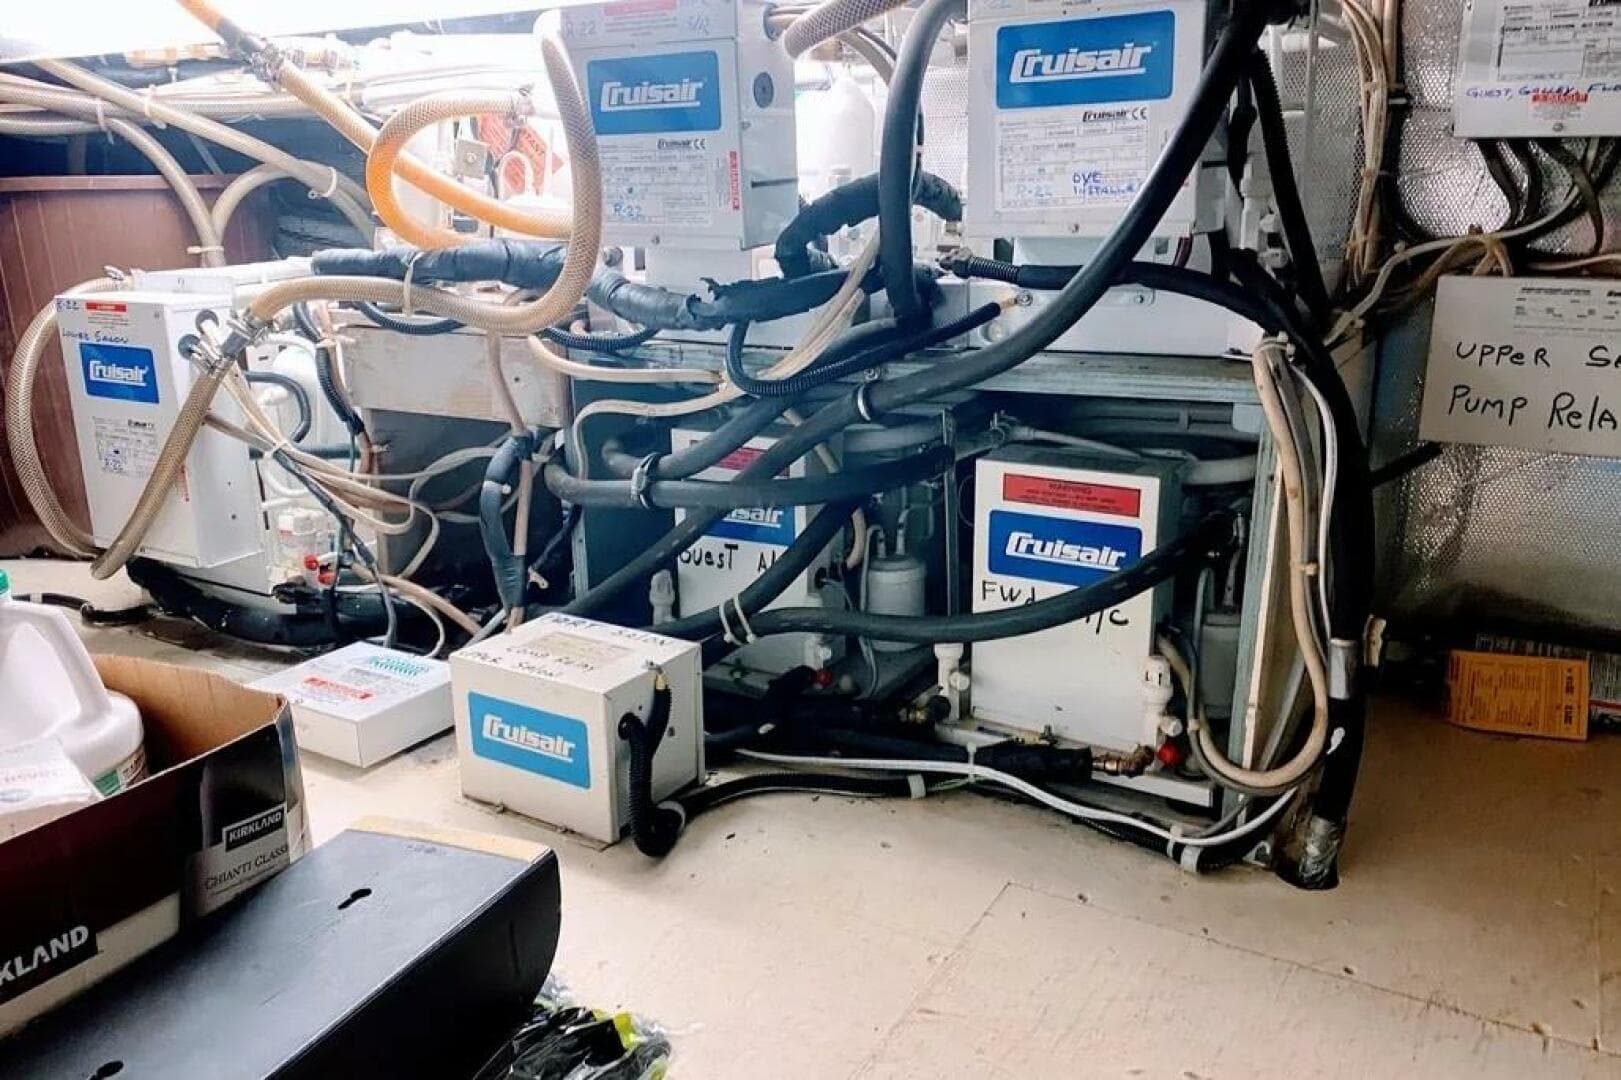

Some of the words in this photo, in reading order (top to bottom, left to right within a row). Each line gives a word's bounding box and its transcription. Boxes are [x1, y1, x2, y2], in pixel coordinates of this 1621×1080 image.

[1008, 42, 1152, 83] Cruisair
[600, 78, 703, 112] Cruisair
[89, 359, 149, 387] Cruisair
[1005, 531, 1126, 572] Cruisair
[482, 713, 576, 764] Cruisair
[229, 811, 282, 842] KIRKLAND
